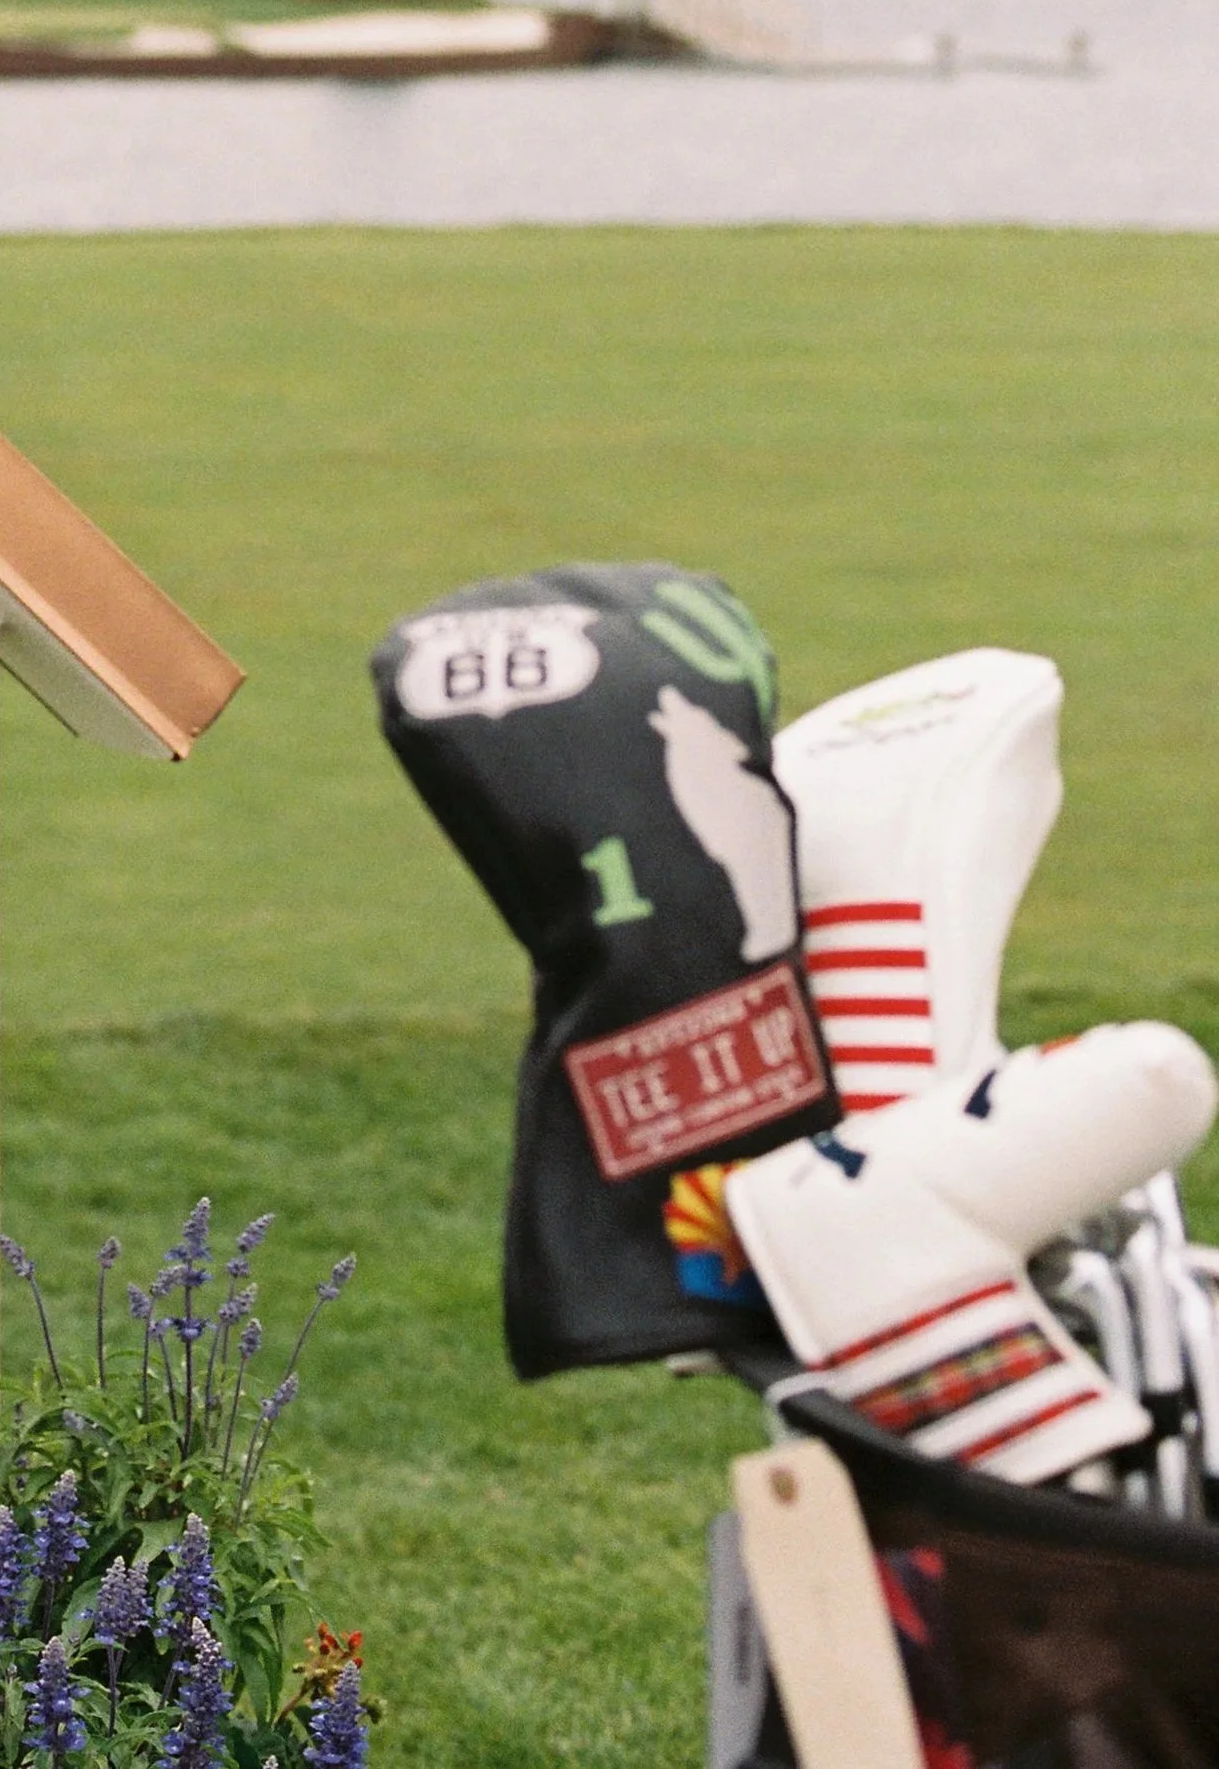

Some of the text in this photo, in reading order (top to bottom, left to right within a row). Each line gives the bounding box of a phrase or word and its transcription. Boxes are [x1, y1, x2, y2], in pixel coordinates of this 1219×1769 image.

[582, 836, 654, 928] 1
[600, 1059, 681, 1128] TEE
[690, 1031, 743, 1094] IT
